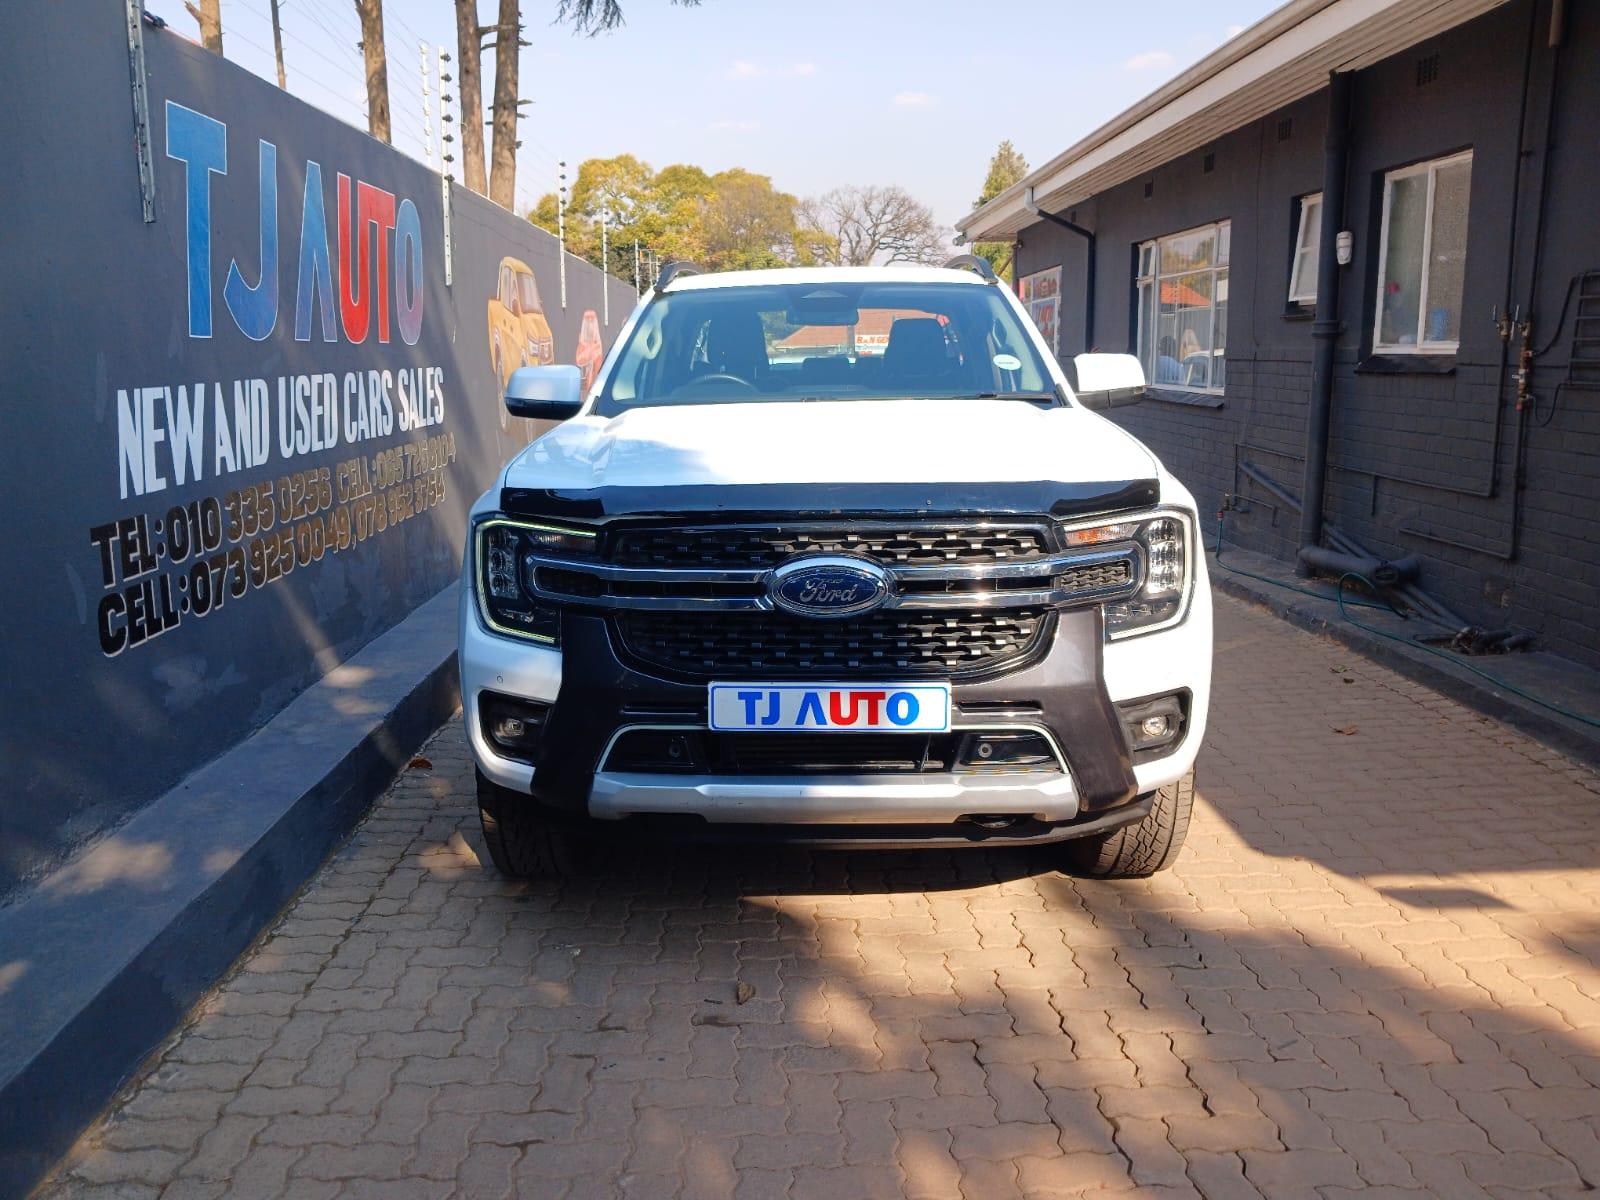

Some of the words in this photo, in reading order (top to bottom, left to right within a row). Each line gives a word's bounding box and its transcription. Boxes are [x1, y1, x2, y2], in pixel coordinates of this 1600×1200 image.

[166, 100, 279, 341] TJ
[295, 159, 424, 345] AUTO
[117, 383, 205, 500] NEW
[215, 378, 269, 476] AND
[278, 373, 338, 458] USED
[344, 369, 393, 445] CARS
[398, 367, 445, 432] SALES
[224, 481, 276, 543] 335
[277, 467, 333, 523] 0256
[250, 526, 296, 589] 925
[800, 578, 858, 602] Ford
[738, 692, 781, 726] TJ
[795, 692, 920, 726] AUTO
